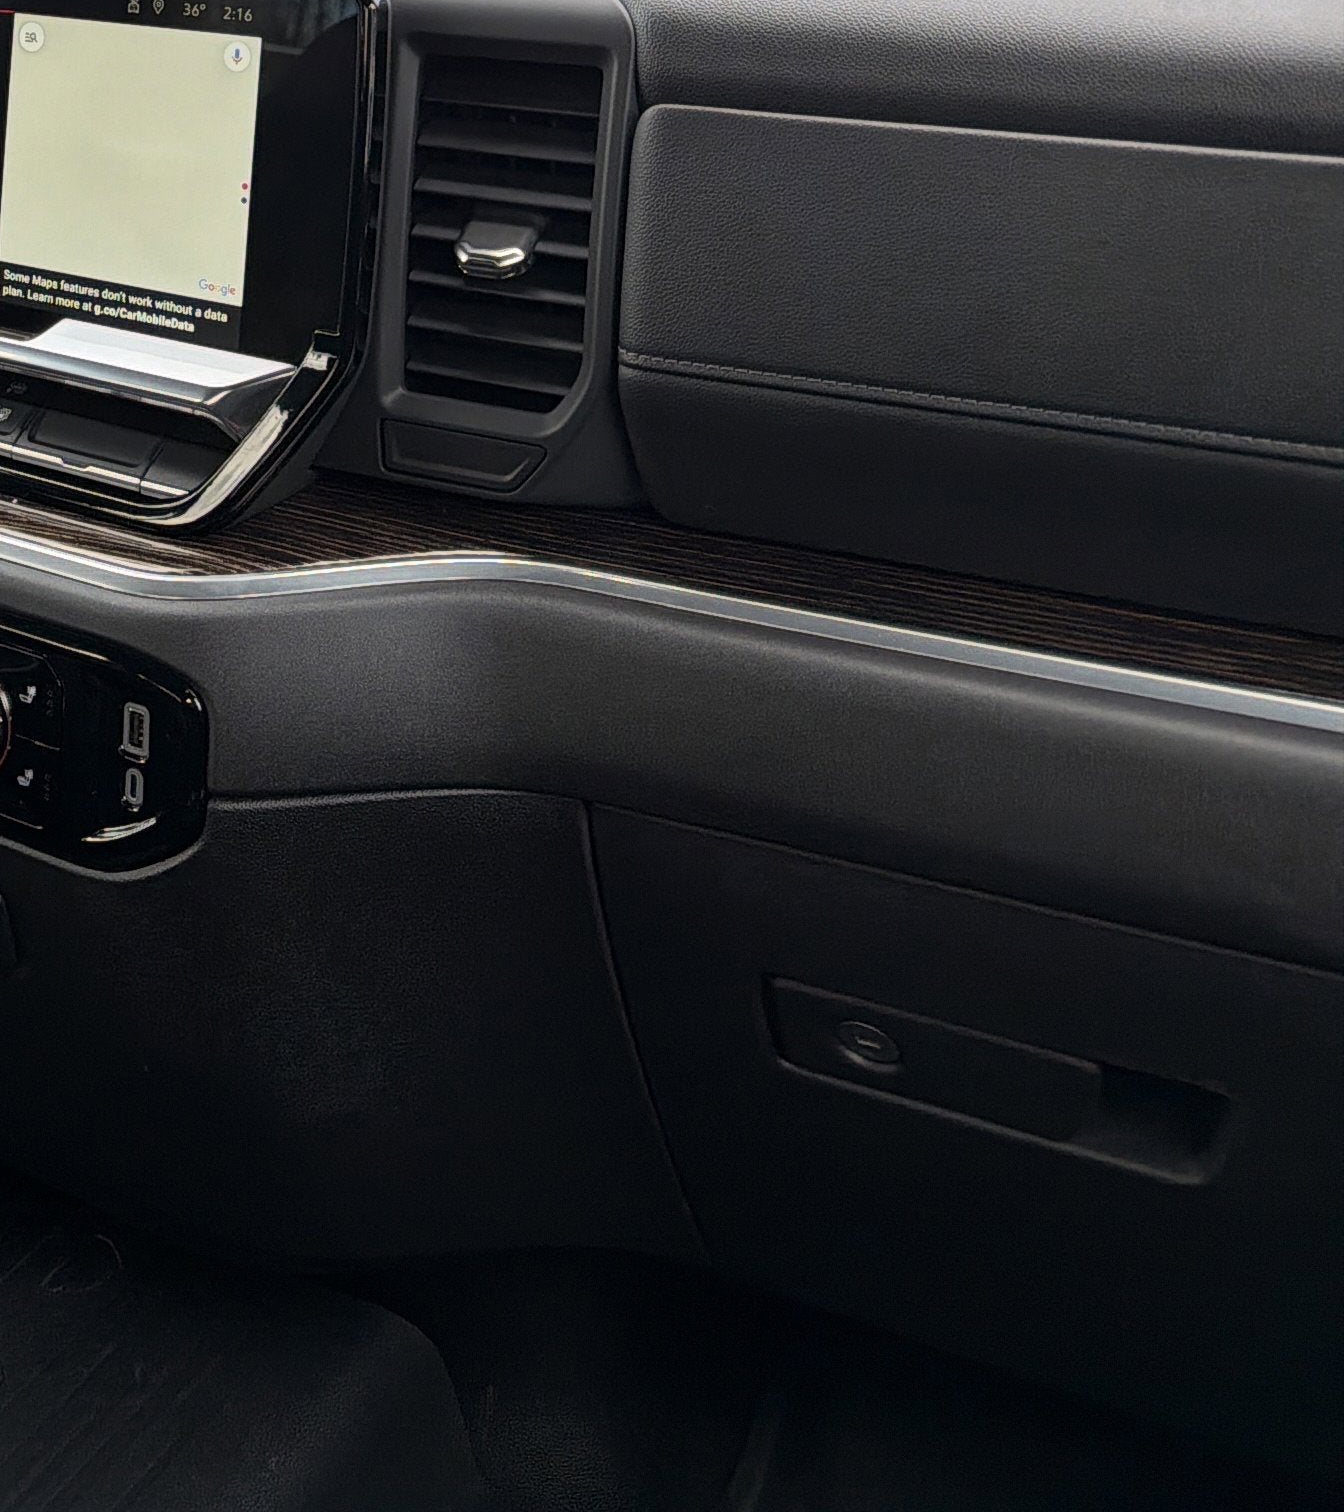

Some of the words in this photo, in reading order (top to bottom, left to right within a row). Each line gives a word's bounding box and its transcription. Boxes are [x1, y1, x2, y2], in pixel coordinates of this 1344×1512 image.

[183, 2, 206, 16] 36°
[223, 7, 252, 22] 2:16
[3, 269, 30, 285] Some
[32, 274, 58, 291] Maps
[60, 279, 100, 298] features
[101, 288, 126, 303] don't
[128, 292, 153, 308] work
[154, 298, 193, 316] without
[194, 308, 202, 318] a
[203, 308, 228, 323] data
[198, 278, 236, 297] Google
[2, 285, 25, 300] plan.
[26, 288, 54, 304] Learn
[55, 296, 80, 310] more
[82, 300, 92, 312] at
[93, 302, 195, 334] g.co/CarMobileData
